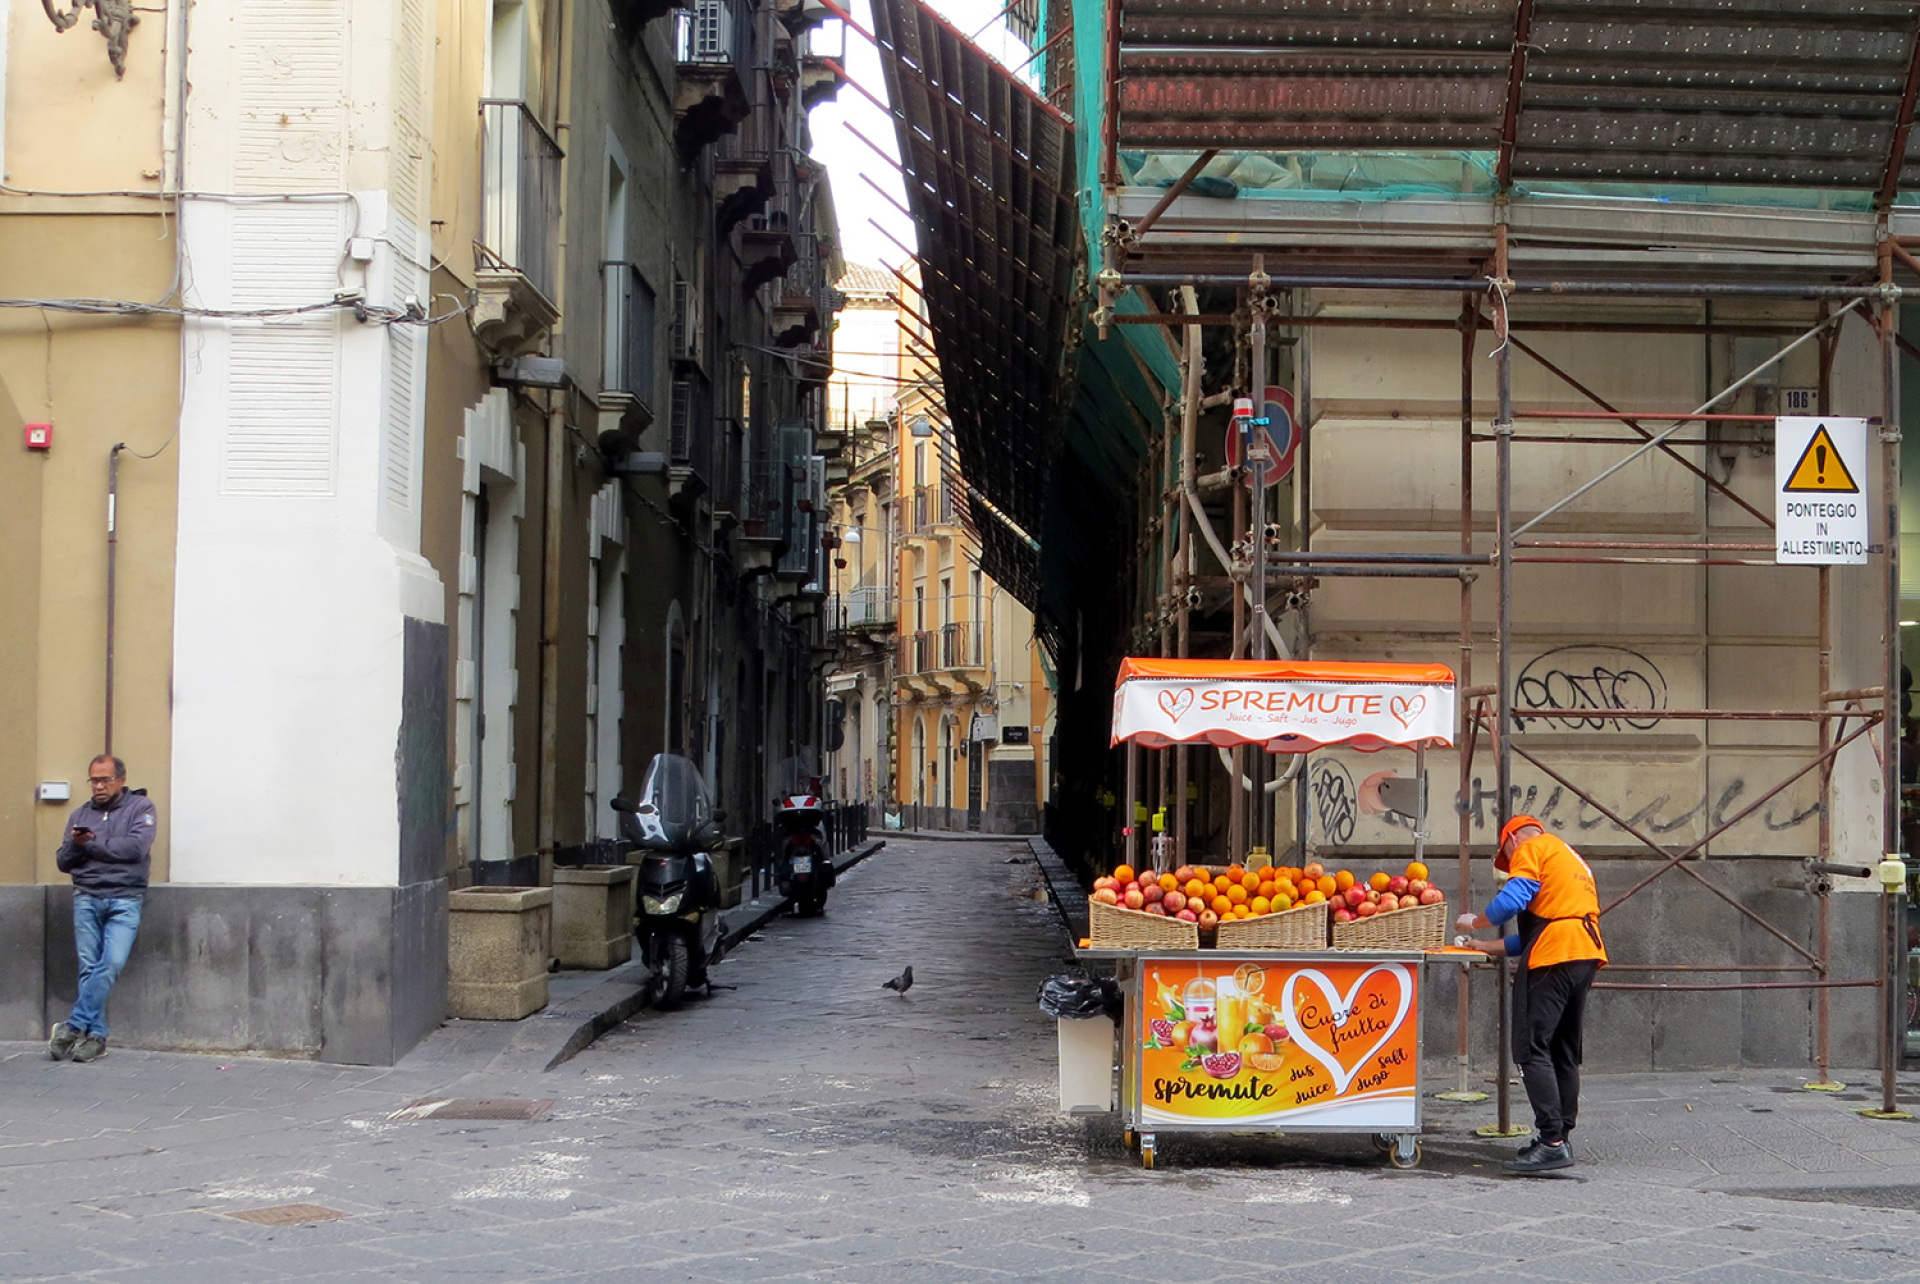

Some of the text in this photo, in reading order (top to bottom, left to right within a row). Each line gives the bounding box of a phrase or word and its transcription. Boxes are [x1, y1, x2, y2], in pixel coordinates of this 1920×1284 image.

[1786, 391, 1808, 408] 186
[1786, 502, 1857, 518] PONTEGGIO
[1816, 522, 1828, 536] IN
[1782, 540, 1863, 556] ALLESTIMENTO
[1200, 689, 1383, 715] SPREMUTE
[1225, 712, 1253, 722] Juice
[1267, 712, 1289, 723] Saft
[1300, 714, 1318, 724] Jus
[1332, 716, 1358, 728] Jugo
[1301, 993, 1388, 1030] Cuore di
[1329, 1017, 1389, 1055] frutta
